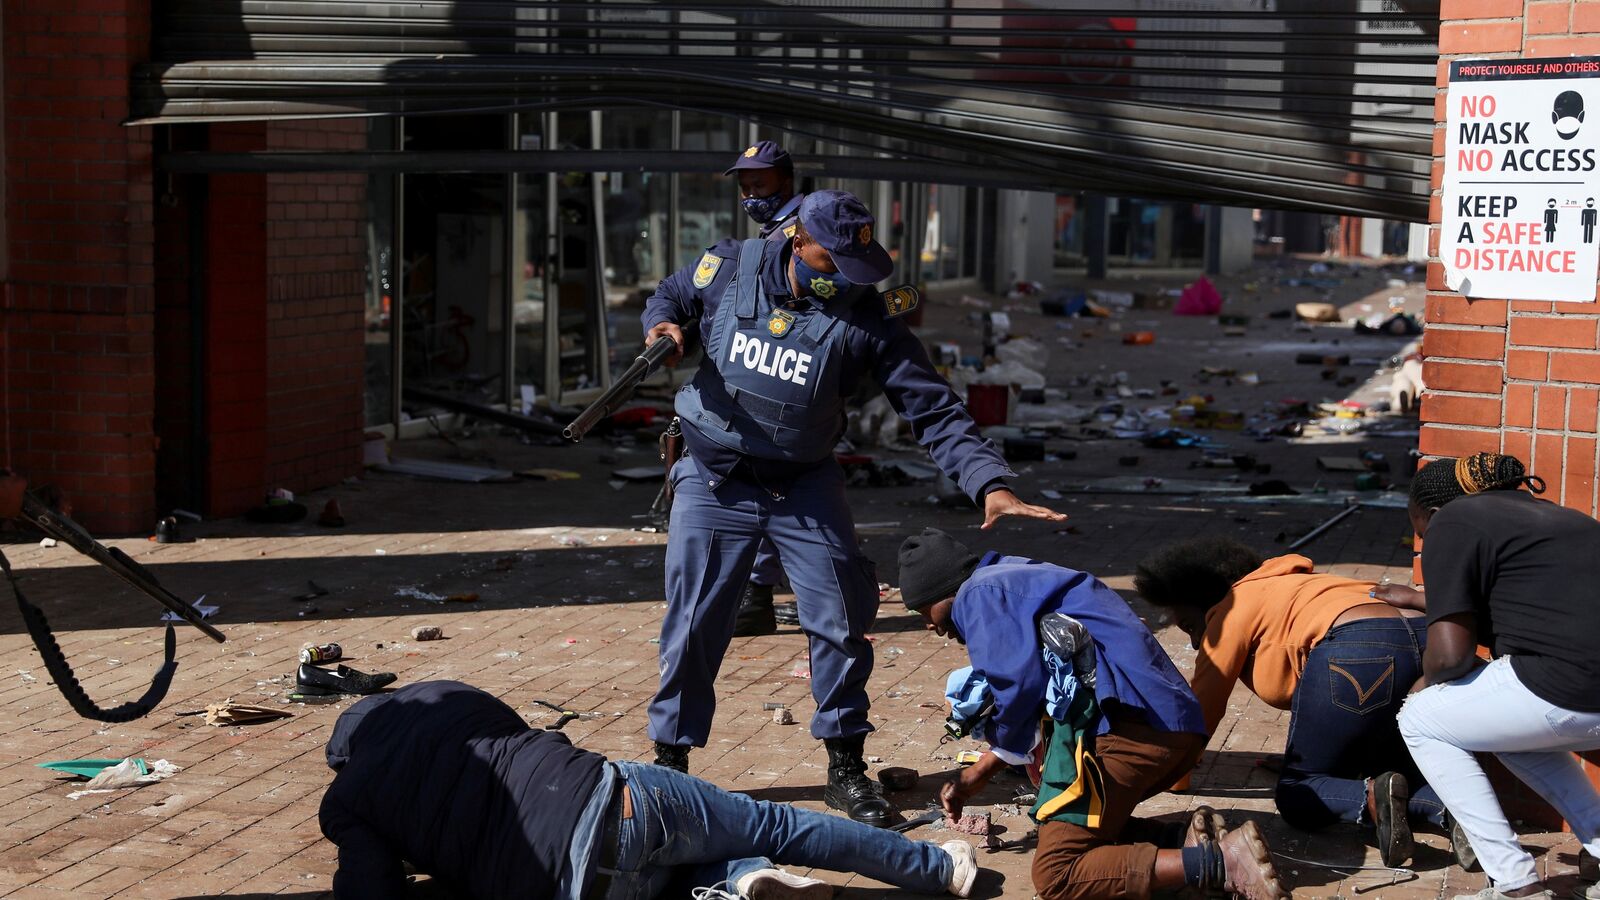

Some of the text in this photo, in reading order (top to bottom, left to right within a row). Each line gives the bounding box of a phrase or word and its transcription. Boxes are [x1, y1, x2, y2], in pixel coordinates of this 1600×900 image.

[1459, 62, 1600, 76] PROTECT YOURSELF AND OTHERS
[1460, 95, 1496, 118] NO
[1458, 121, 1530, 145] MASK
[1457, 148, 1596, 172] NO ACCESS
[1457, 195, 1518, 218] KEEP
[1456, 221, 1542, 245] A SAFE
[1454, 248, 1576, 273] DISTANCE
[728, 331, 812, 386] POLICE
